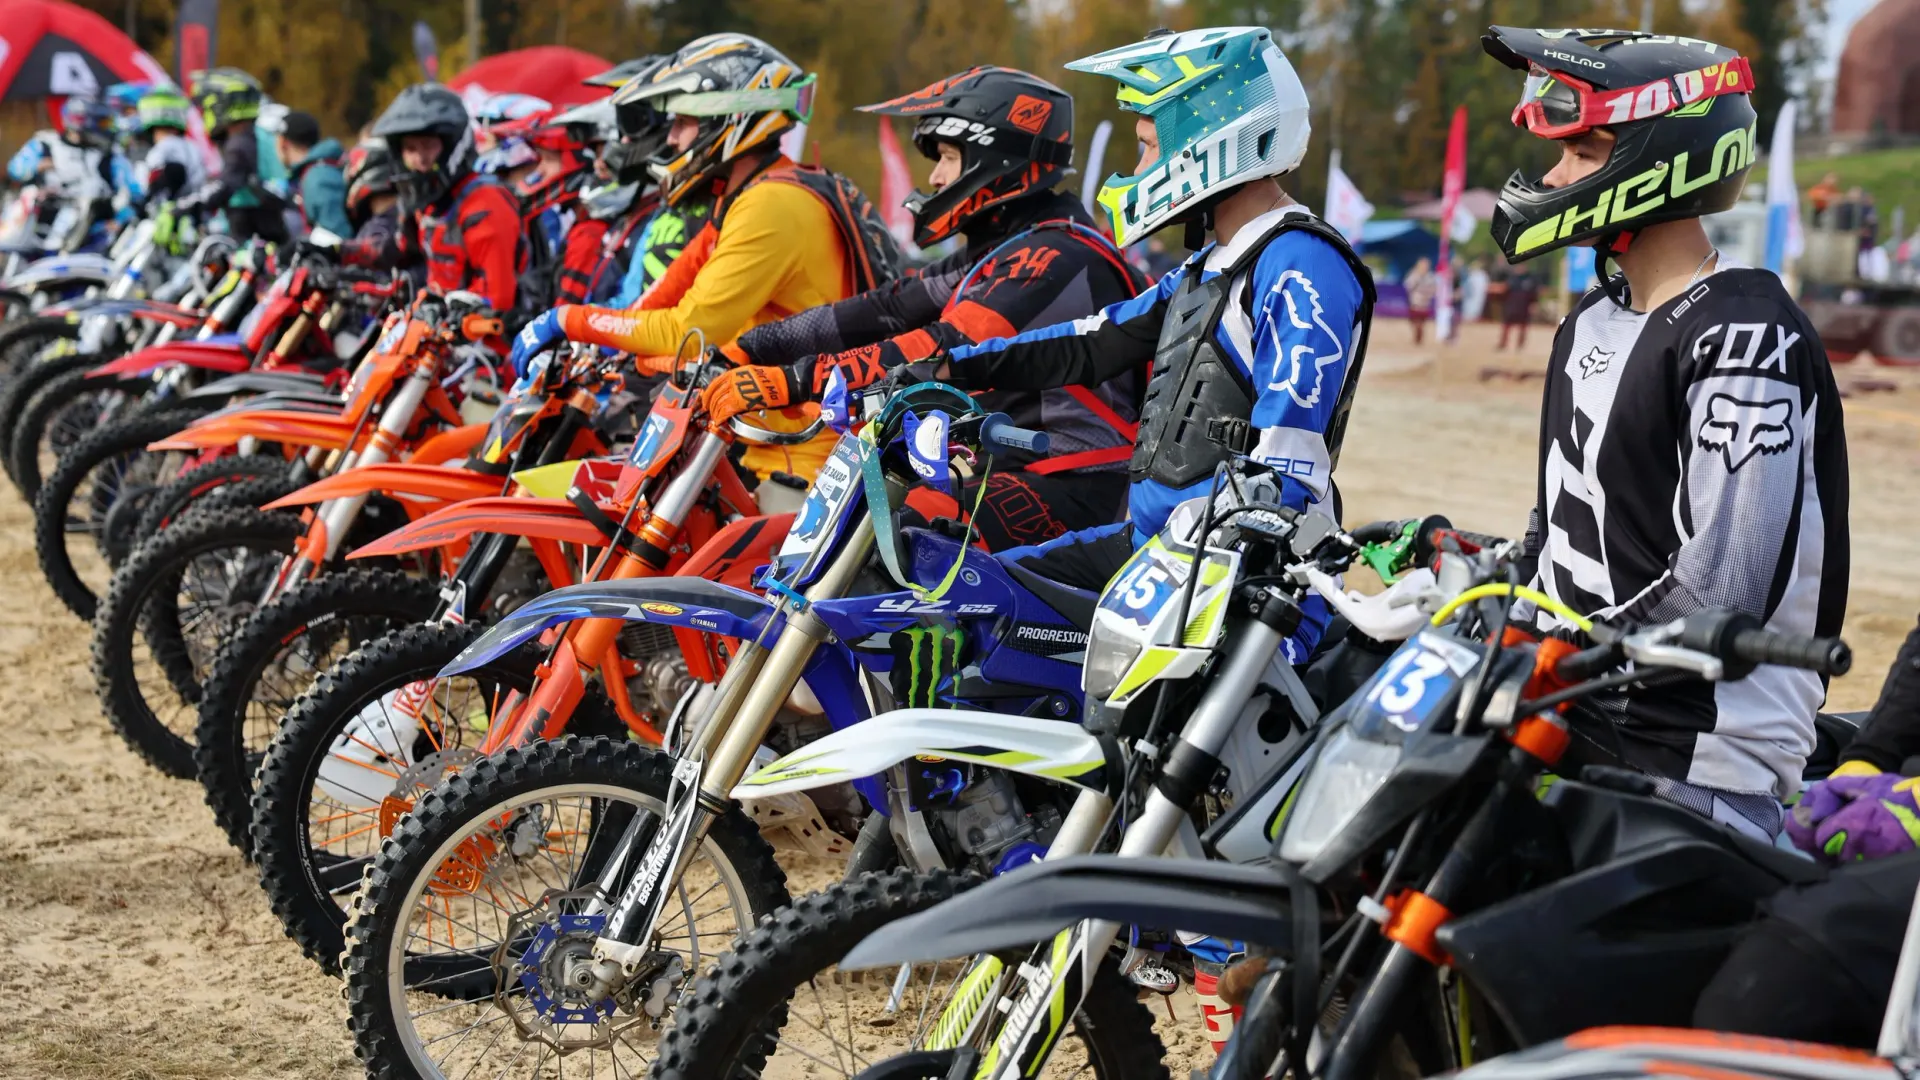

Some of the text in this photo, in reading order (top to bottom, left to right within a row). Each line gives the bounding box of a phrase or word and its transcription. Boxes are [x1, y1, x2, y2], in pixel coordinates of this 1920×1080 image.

[1544, 49, 1606, 70] HELMO
[1605, 60, 1739, 124] 100%
[735, 369, 768, 409] FOX
[813, 345, 887, 394] FOX
[873, 599, 998, 614] YZ 125
[1112, 560, 1168, 611] 45
[696, 618, 717, 629] YAMAHA
[1368, 648, 1448, 712] 13
[638, 843, 672, 907] BRAKING
[1000, 960, 1054, 1058] PROGASI
